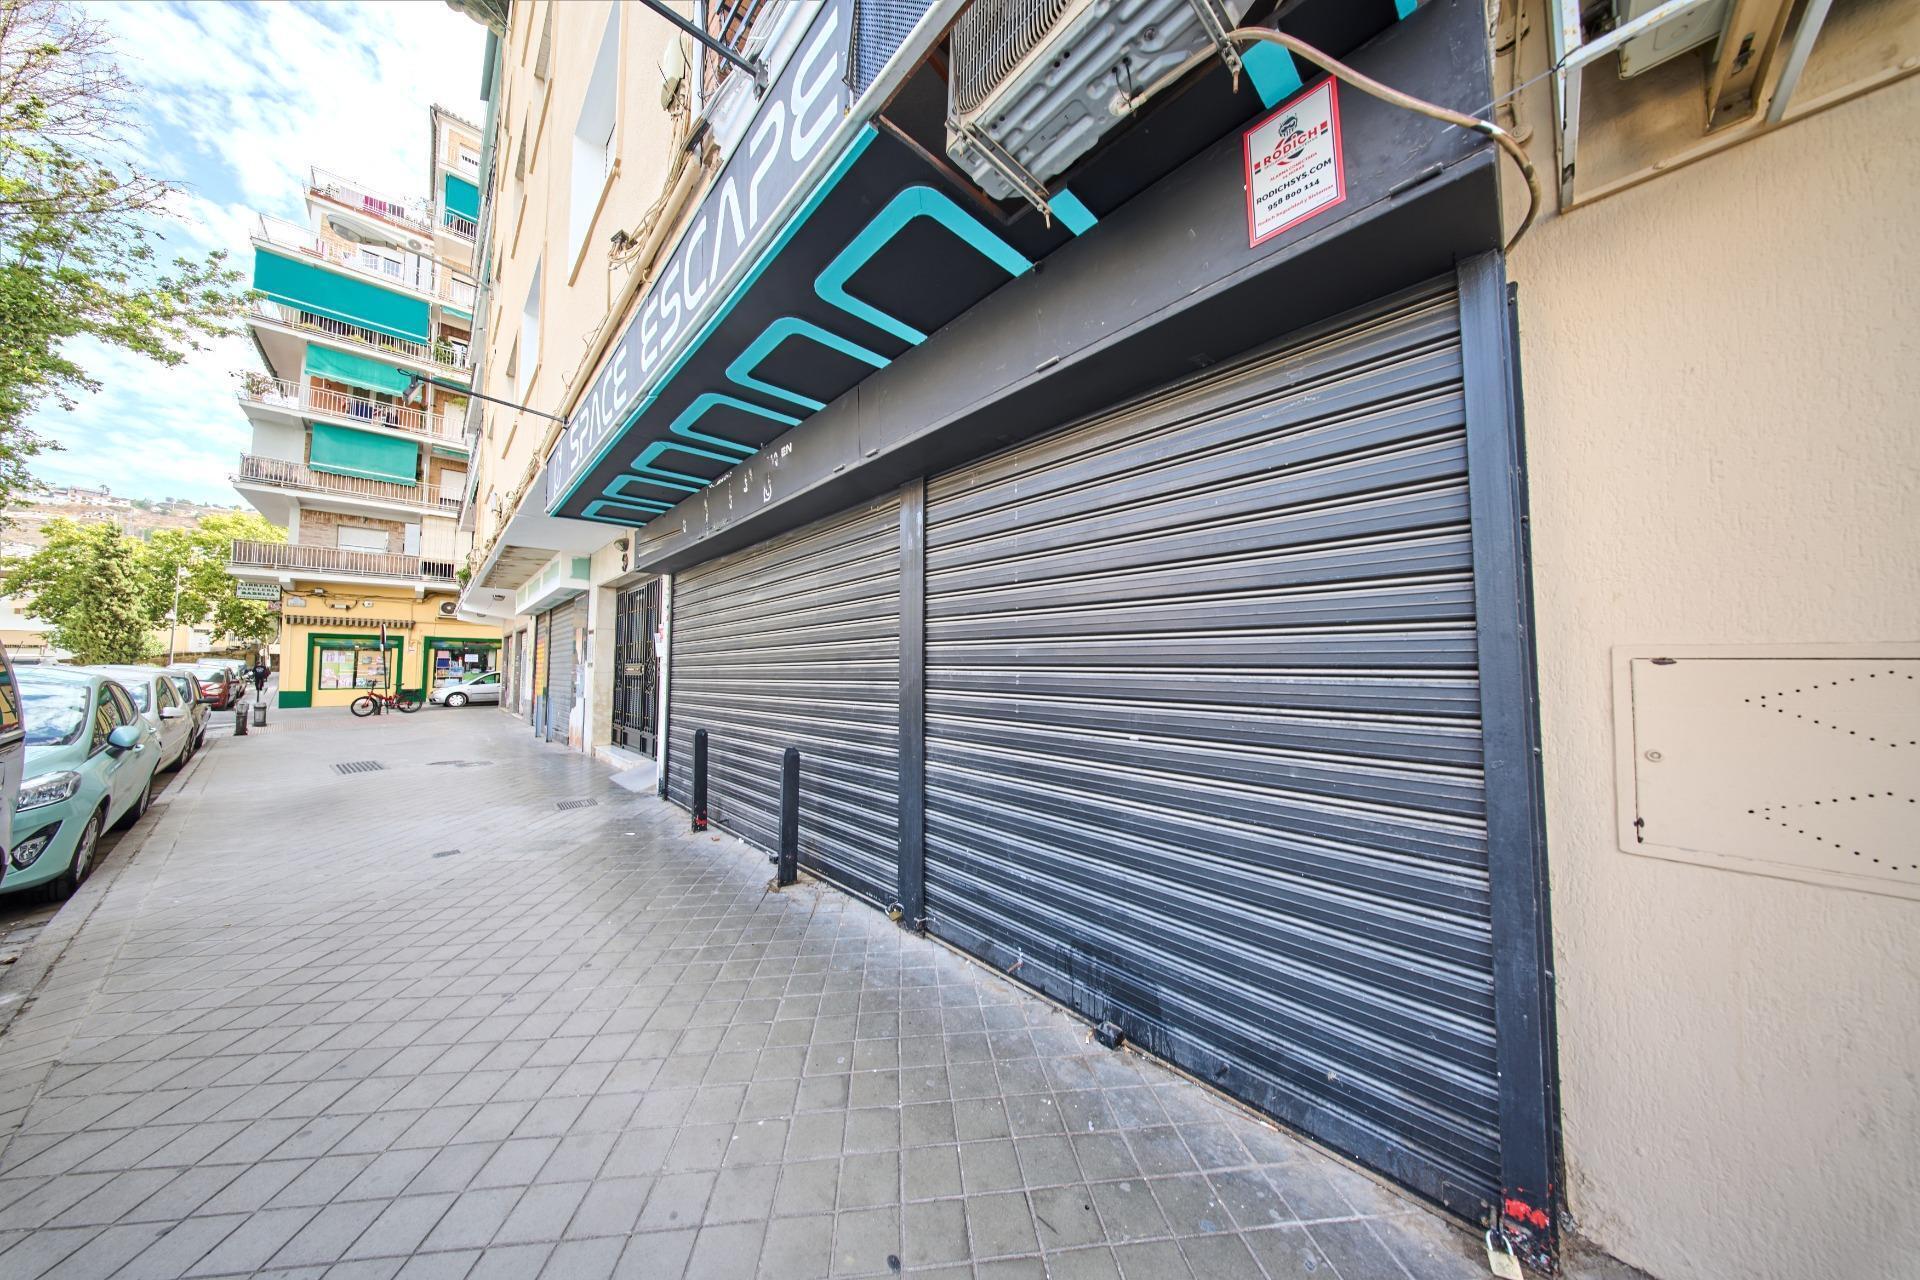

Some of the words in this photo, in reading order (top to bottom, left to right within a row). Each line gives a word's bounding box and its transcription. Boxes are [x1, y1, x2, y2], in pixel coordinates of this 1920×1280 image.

[1263, 127, 1318, 165] RODICH
[1256, 158, 1332, 205] RODICHSYS.COM
[1267, 199, 1283, 211] 958
[1285, 188, 1302, 200] 800
[1304, 179, 1320, 191] 114
[570, 344, 627, 469] SPACE
[640, 6, 839, 373] ESCAPE
